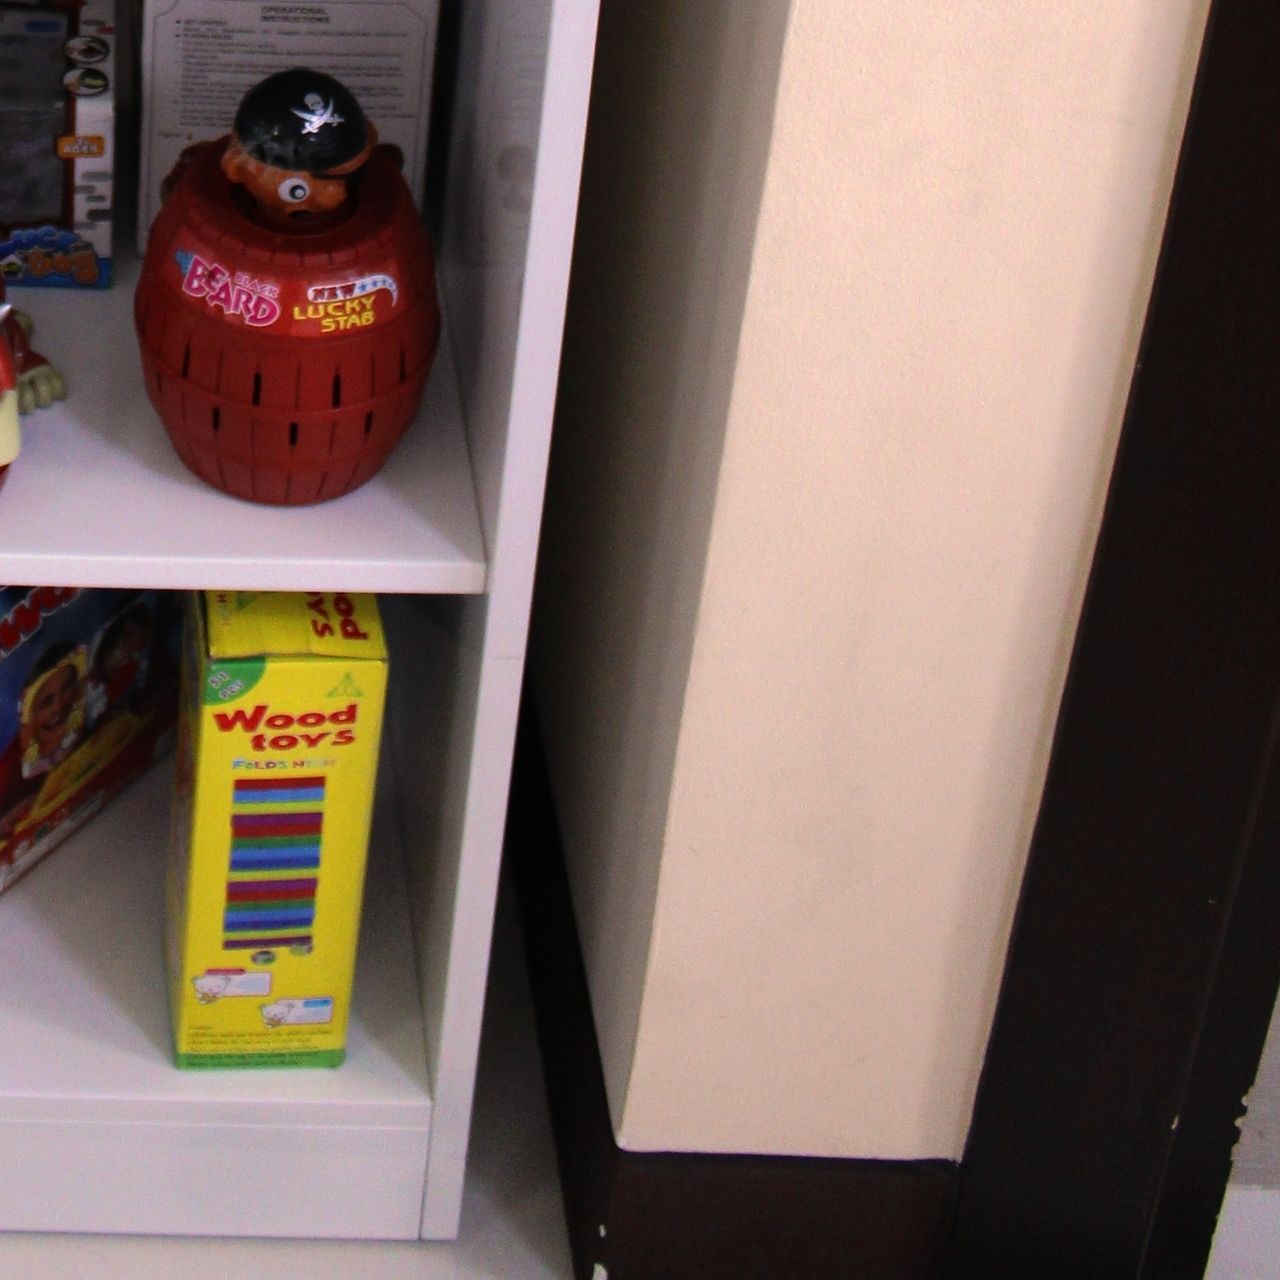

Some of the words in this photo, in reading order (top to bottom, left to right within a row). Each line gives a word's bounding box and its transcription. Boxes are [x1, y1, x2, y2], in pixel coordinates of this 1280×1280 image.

[182, 255, 280, 327] BEARD
[234, 271, 280, 299] BLACK
[311, 284, 356, 301] NEW
[293, 295, 376, 321] LUCKY
[321, 311, 375, 333] STAB
[213, 703, 358, 733] Wood
